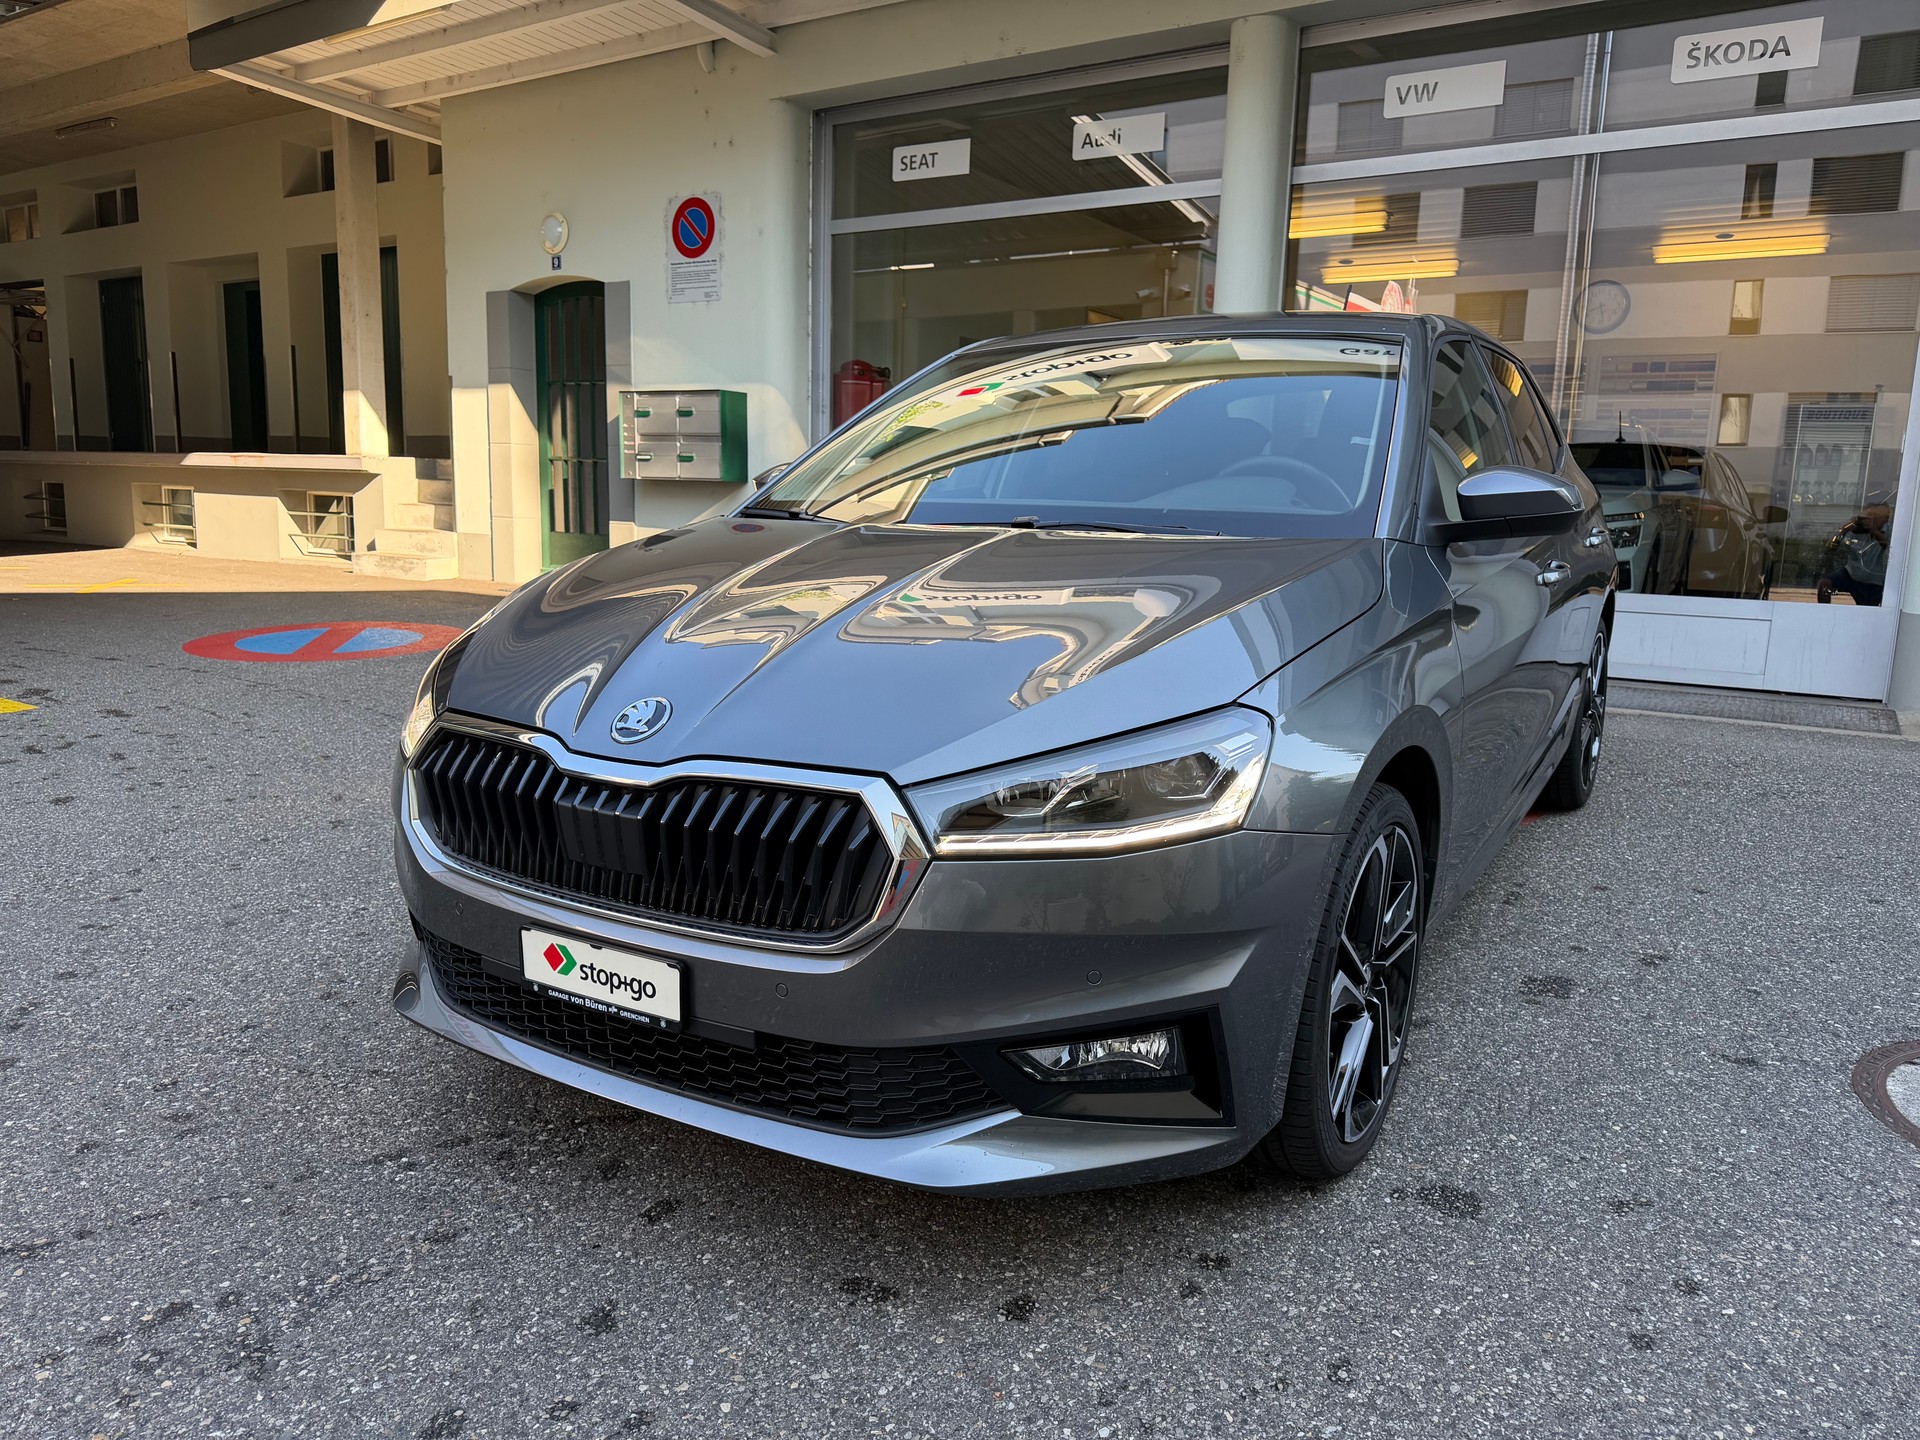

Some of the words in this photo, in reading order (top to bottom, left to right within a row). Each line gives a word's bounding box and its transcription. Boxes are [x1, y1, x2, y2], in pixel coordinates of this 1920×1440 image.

[1686, 35, 1791, 69] ŠKODA
[1396, 81, 1439, 105] VW
[900, 152, 938, 172] SEAT
[553, 257, 559, 268] 9
[579, 962, 656, 1001] stop+go
[548, 989, 569, 1001] GARAGE
[570, 995, 584, 1005] von
[585, 998, 608, 1013] Büren
[619, 1010, 650, 1023] GRENCHEN
